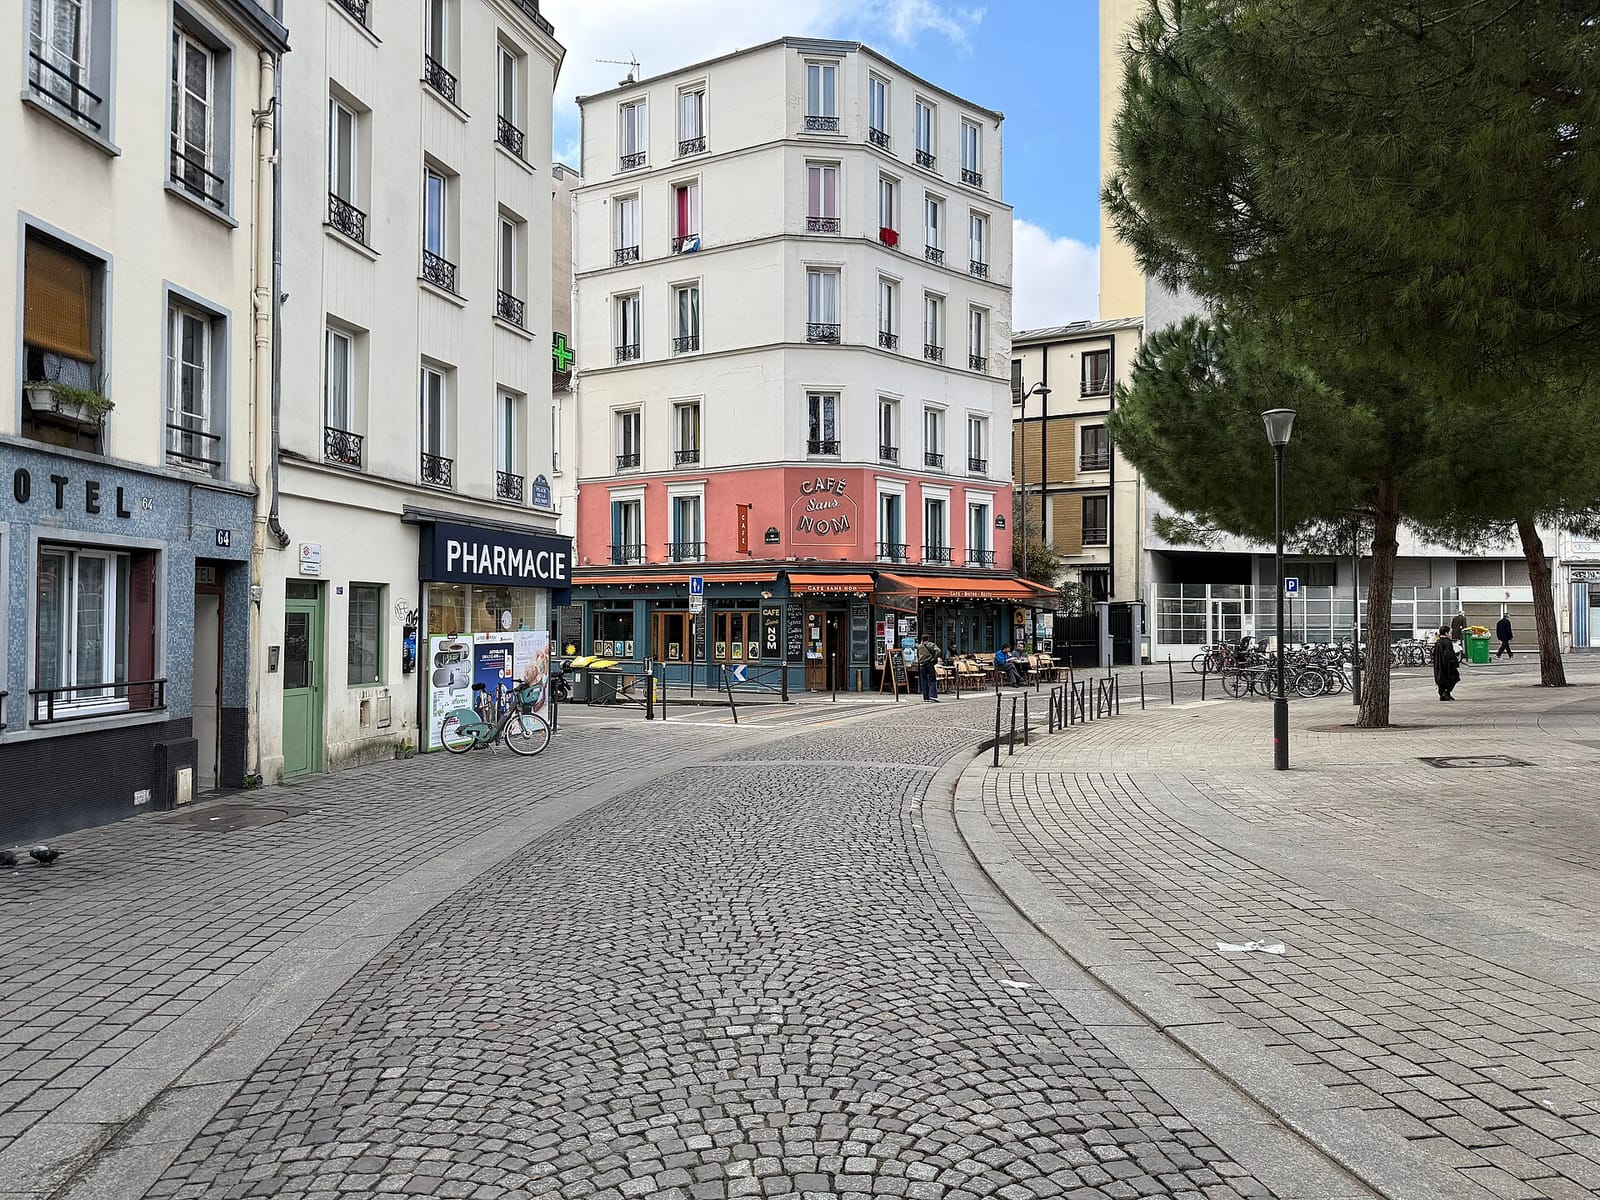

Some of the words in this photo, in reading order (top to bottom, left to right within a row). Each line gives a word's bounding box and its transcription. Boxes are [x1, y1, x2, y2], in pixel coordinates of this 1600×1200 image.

[801, 477, 846, 496] CAFÉ
[142, 497, 153, 510] 64
[806, 497, 839, 512] Sans
[797, 514, 850, 536] NOM
[218, 530, 229, 545] 64
[447, 540, 566, 579] PHARMACIE
[1288, 580, 1295, 590] P
[767, 627, 777, 650] NOM
